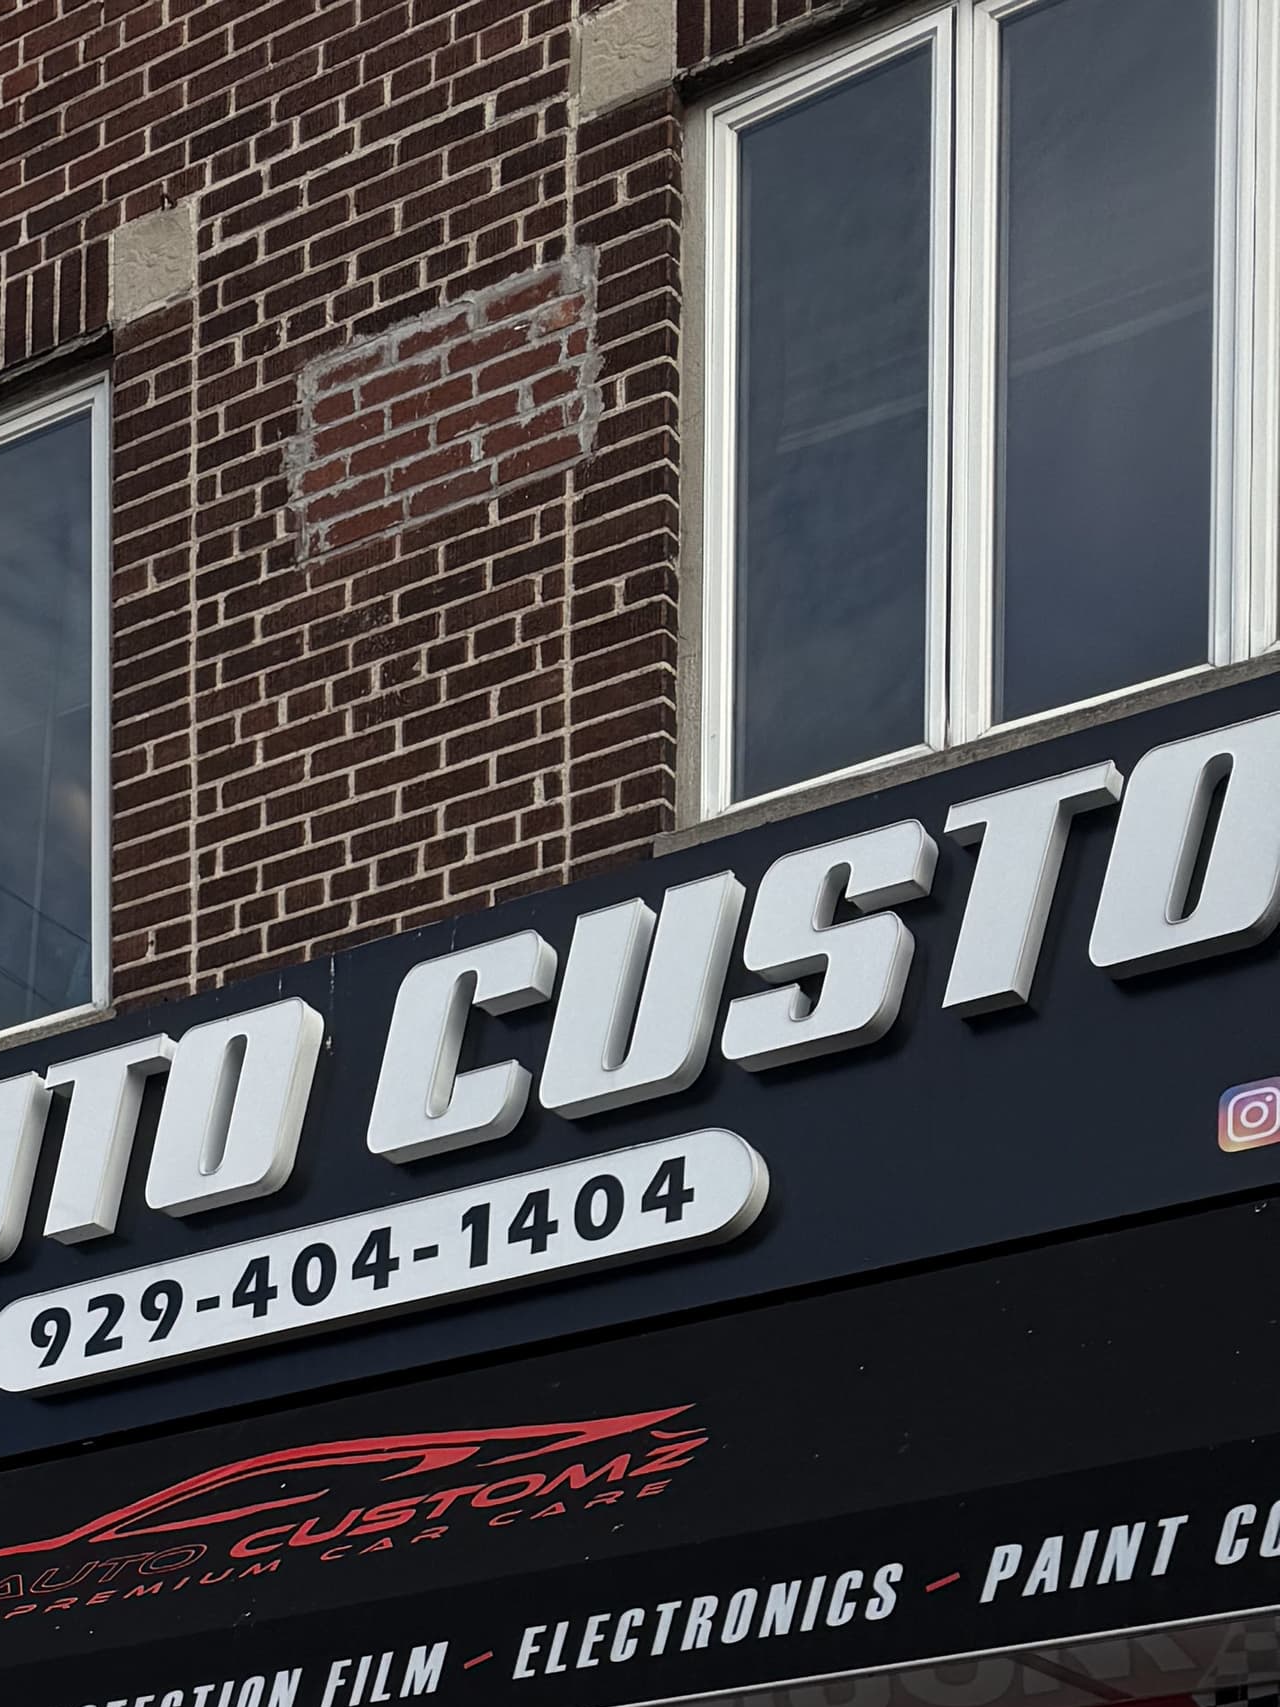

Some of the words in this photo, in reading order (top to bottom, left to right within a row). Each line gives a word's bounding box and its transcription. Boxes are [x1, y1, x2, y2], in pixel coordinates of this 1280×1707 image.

[366, 710, 1280, 1165] CUSTO
[29, 1156, 695, 1370] 929-404-1404
[4, 1561, 281, 1620] PREMIUM
[320, 1528, 448, 1561] CAR
[488, 1480, 670, 1528] CARE
[511, 1561, 904, 1680] ELECTRONICS
[979, 1514, 1189, 1604] PAINT
